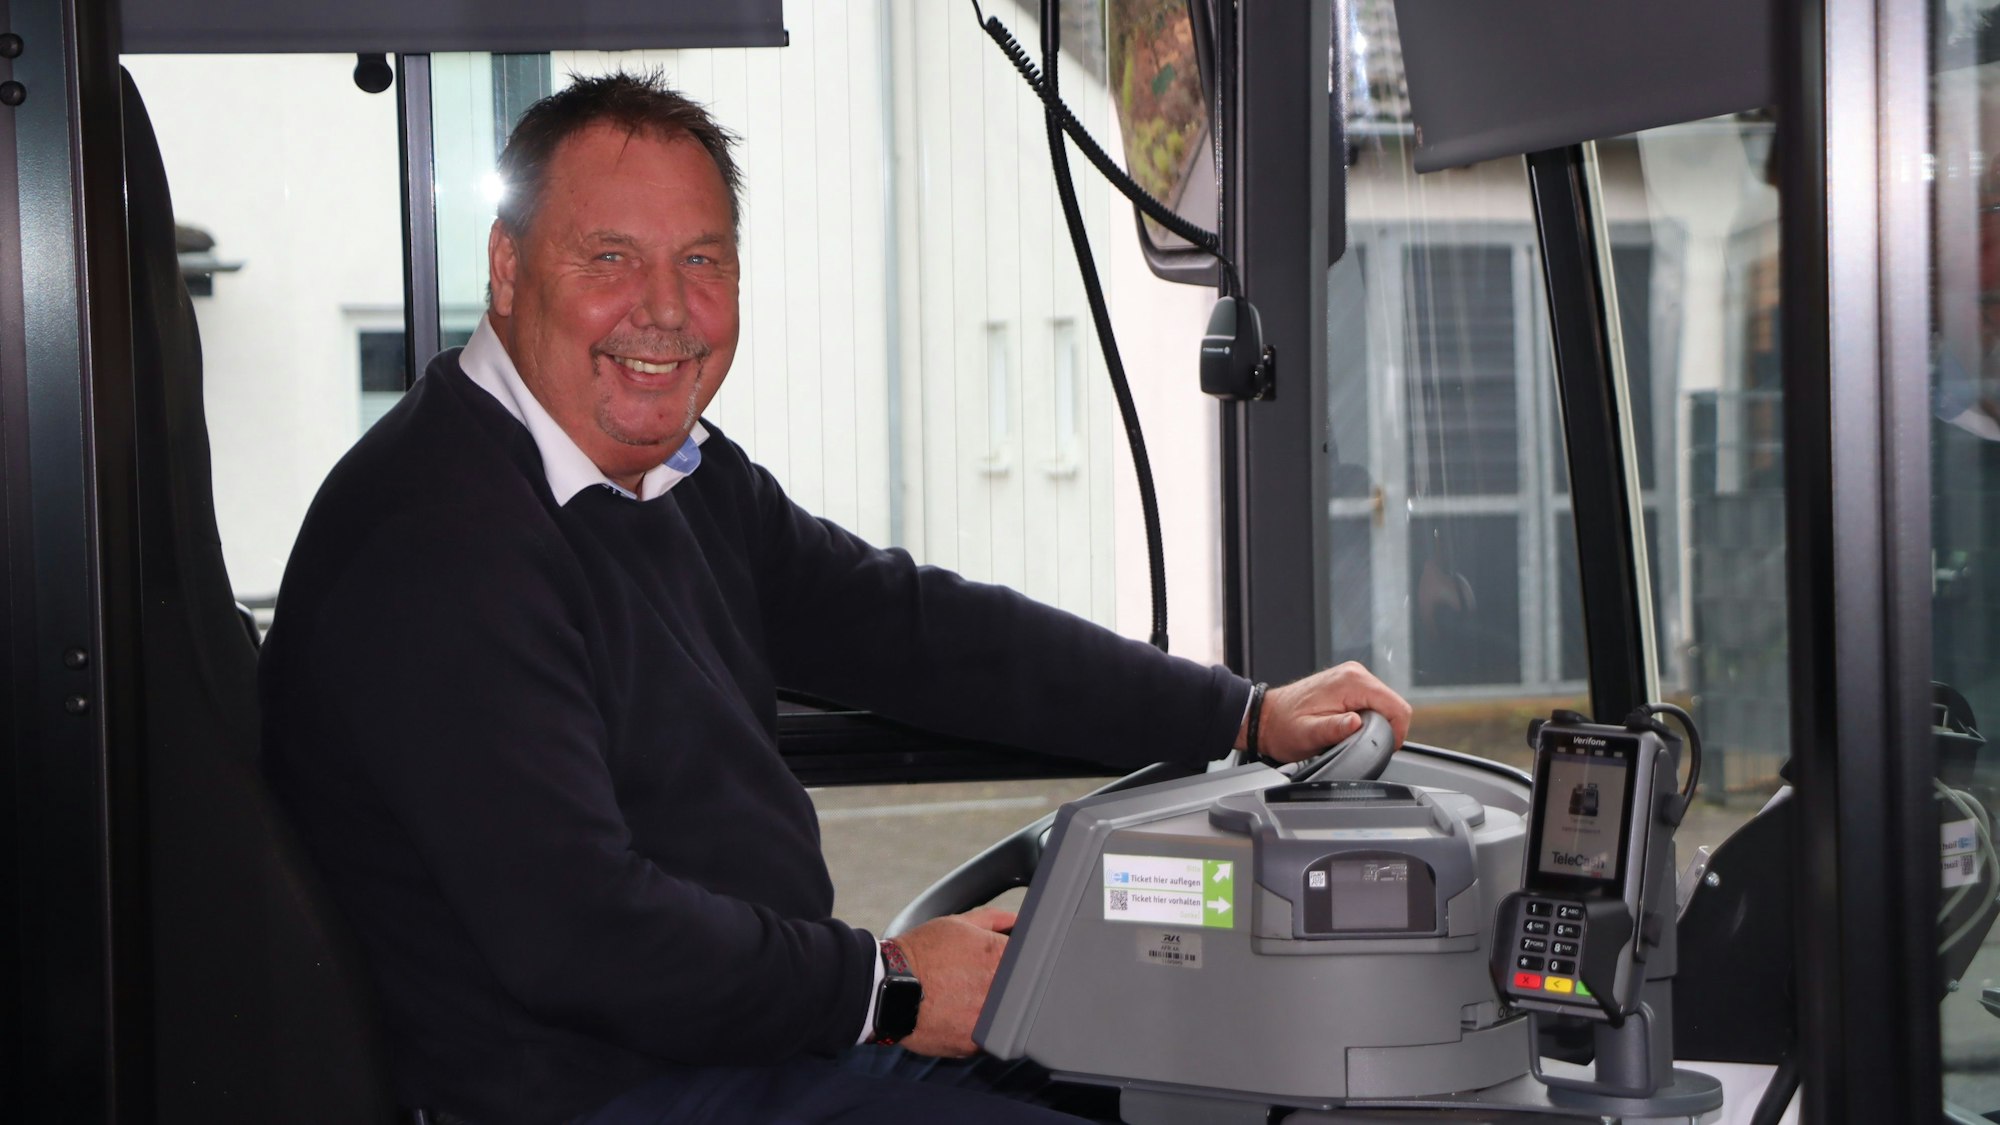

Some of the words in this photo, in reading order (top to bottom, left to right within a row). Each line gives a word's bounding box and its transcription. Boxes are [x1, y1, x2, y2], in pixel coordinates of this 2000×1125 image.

[1573, 736, 1607, 747] Verifone
[1552, 851, 1605, 869] TeleCah
[1131, 874, 1152, 883] Ticket
[1153, 875, 1168, 885] hier
[1169, 876, 1201, 887] auflegen
[1132, 894, 1152, 904] Ticket
[1153, 895, 1167, 904] hier
[1168, 896, 1201, 906] vorhalten
[1532, 904, 1537, 913] 1
[1560, 907, 1567, 917] 2
[1526, 922, 1533, 931] 4
[1557, 925, 1564, 934] 5
[1524, 939, 1531, 948] 7
[1554, 943, 1561, 953] 8
[1551, 961, 1558, 970] 0
